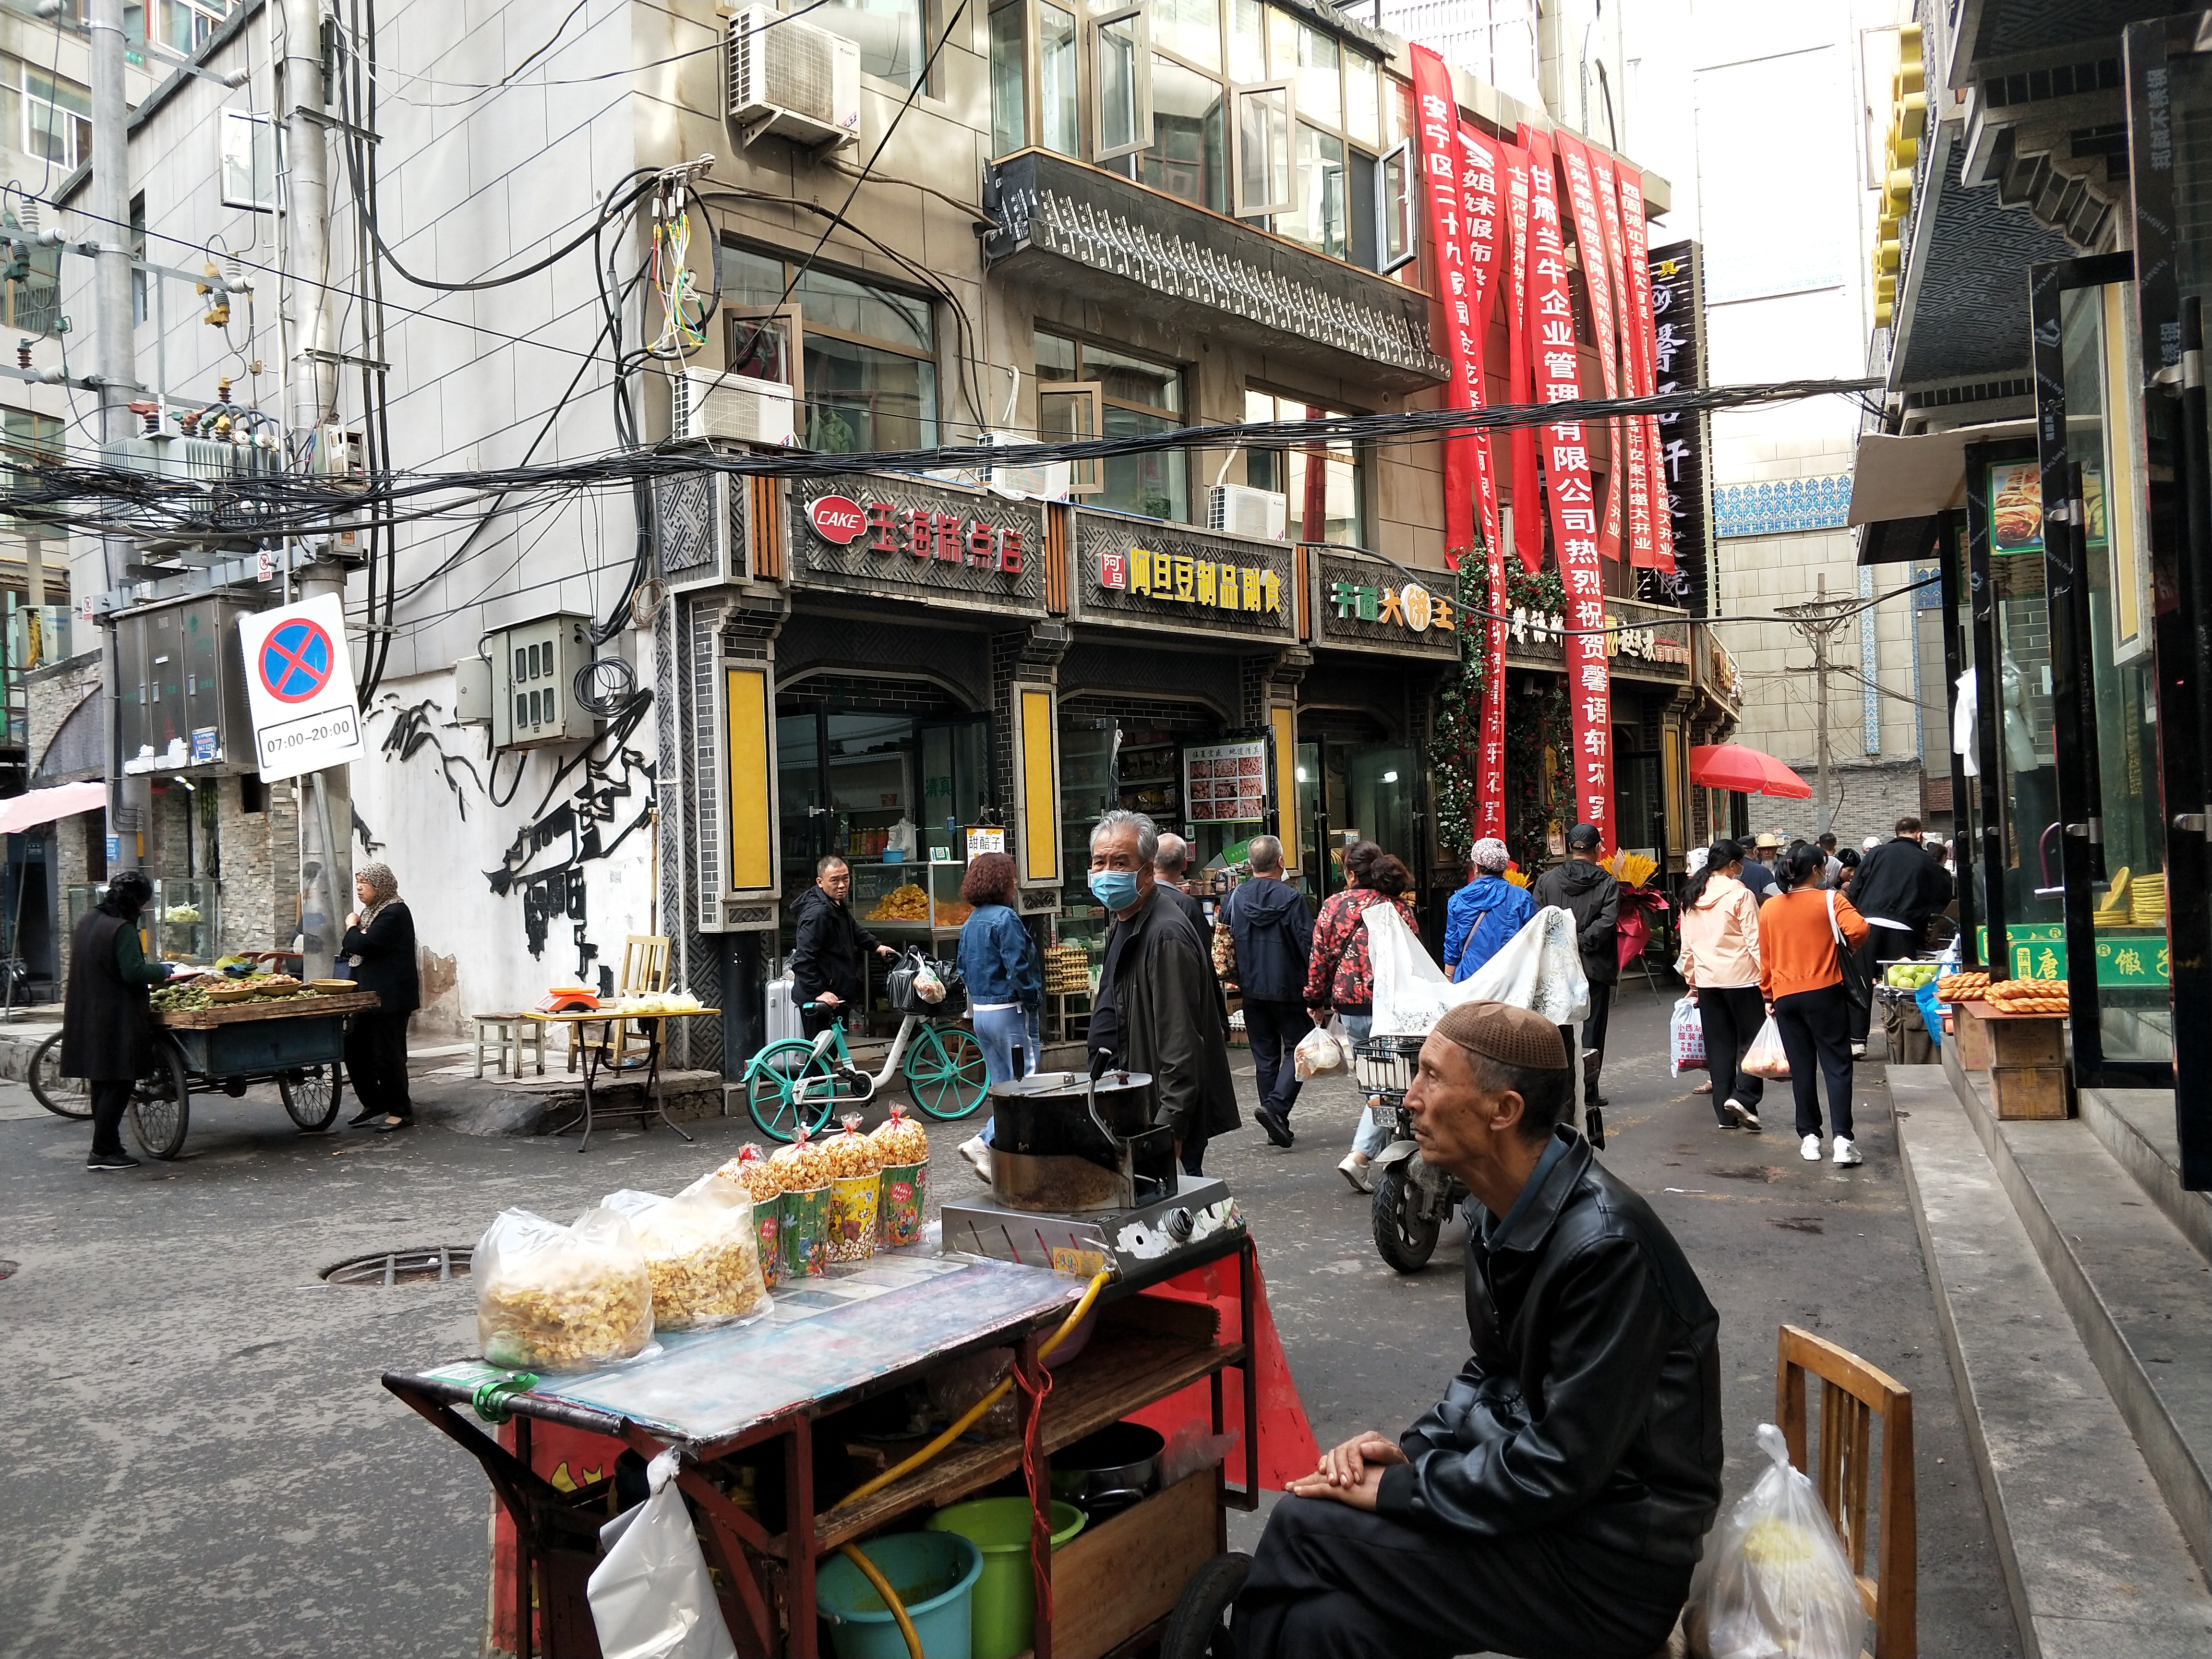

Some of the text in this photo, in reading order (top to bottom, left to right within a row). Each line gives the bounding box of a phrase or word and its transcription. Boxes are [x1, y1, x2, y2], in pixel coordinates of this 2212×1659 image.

[817, 510, 861, 529] CAKE
[866, 502, 1024, 574] 玉海糕点店
[1127, 547, 1280, 613] 阿旦豆制品副食
[1656, 645, 1691, 665] 手工面条
[267, 721, 349, 753] 07:00-20:00
[925, 776, 951, 798] 清真
[969, 835, 1001, 850] 甜醅子
[2018, 950, 2030, 976] 清真
